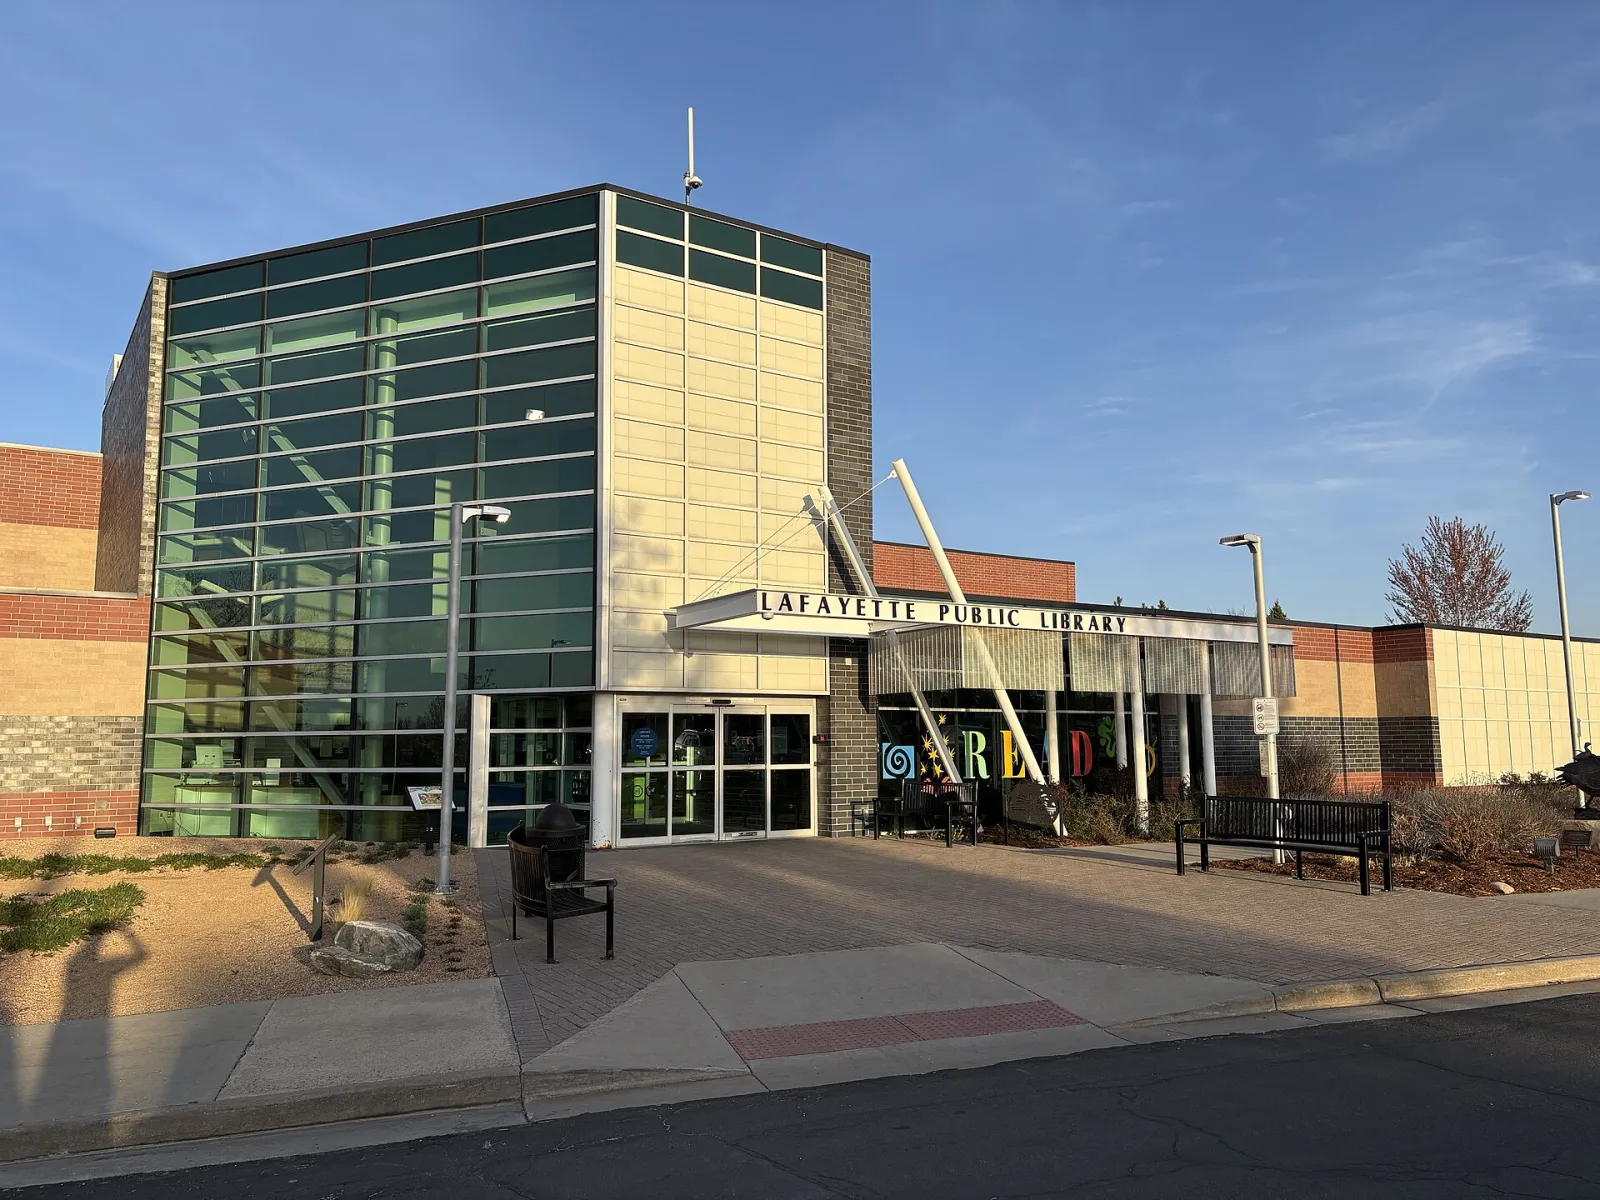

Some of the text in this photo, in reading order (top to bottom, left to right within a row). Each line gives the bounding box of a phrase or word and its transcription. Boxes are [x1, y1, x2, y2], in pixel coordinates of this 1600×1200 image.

[761, 592, 1127, 633] LAFAYETTE PUBLIC LIBRARY
